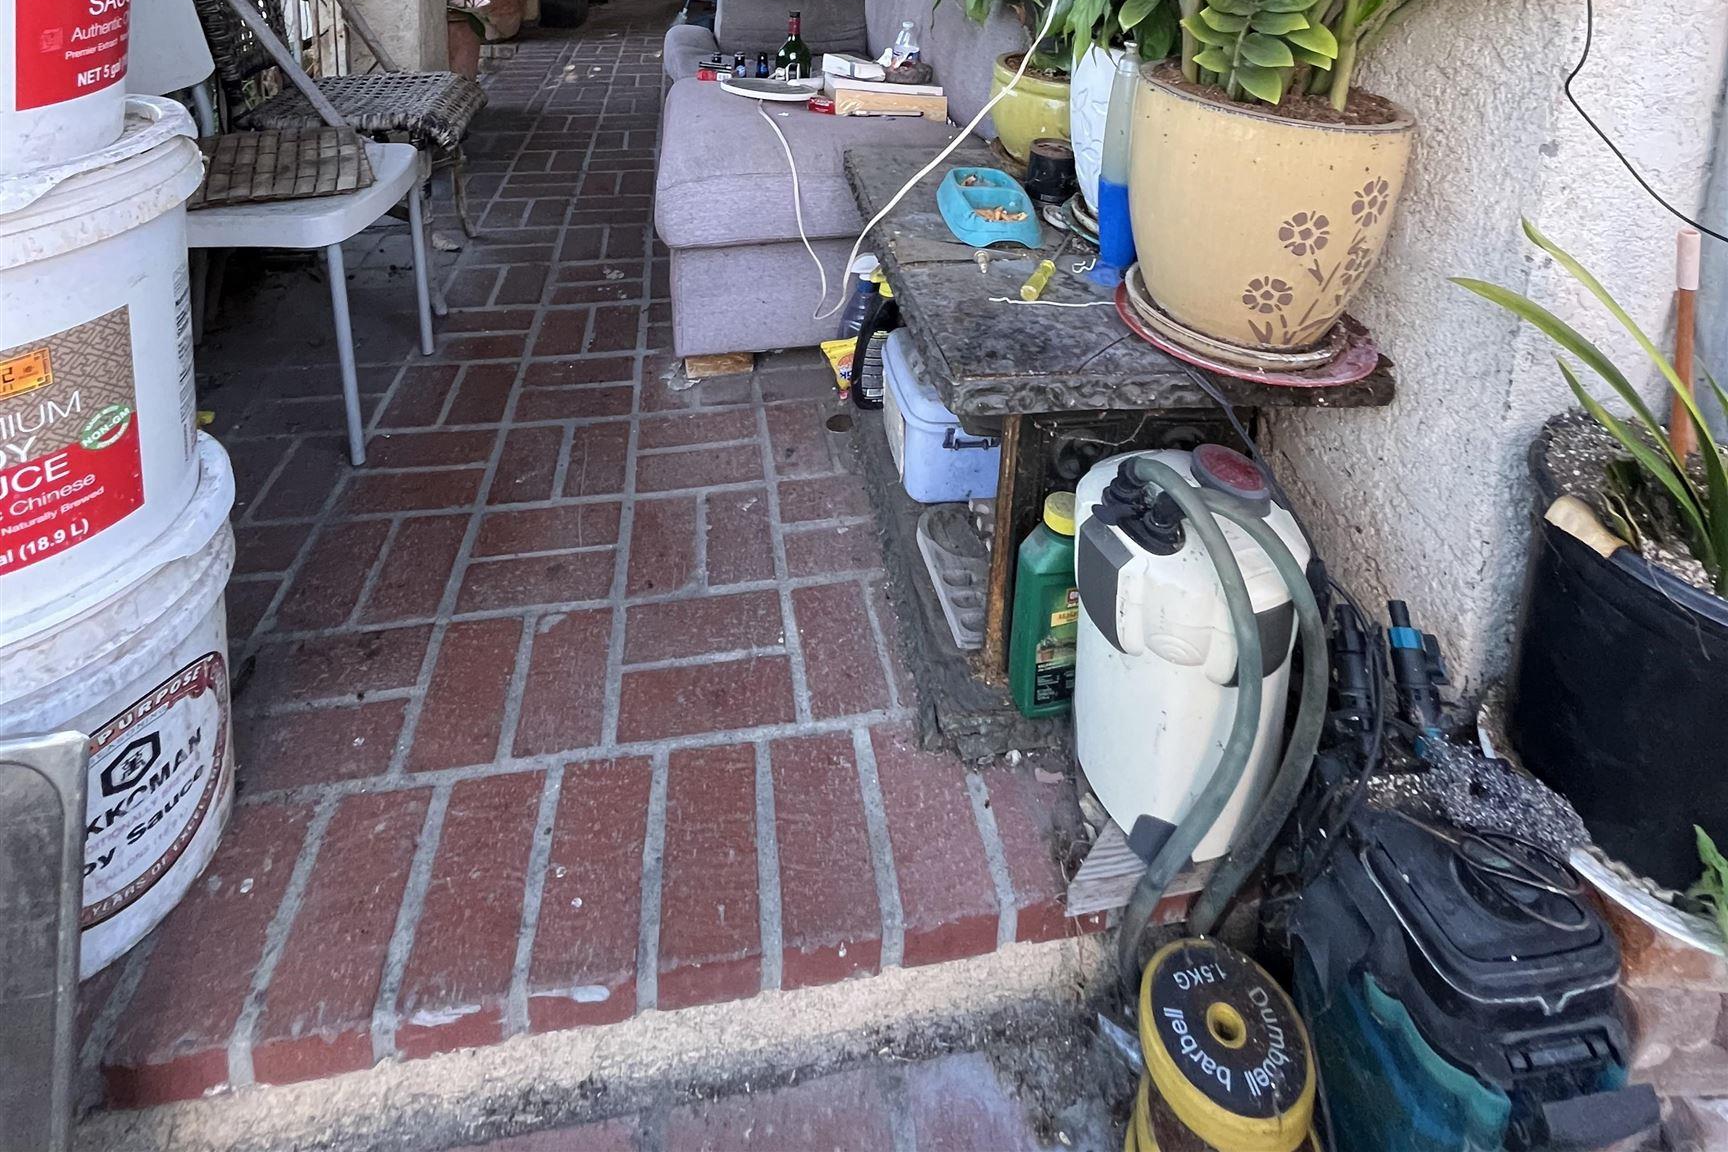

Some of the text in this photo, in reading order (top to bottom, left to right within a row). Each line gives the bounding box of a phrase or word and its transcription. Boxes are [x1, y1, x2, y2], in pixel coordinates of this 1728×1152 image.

[78, 67, 102, 87] NET
[104, 64, 109, 77] 5
[1, 486, 104, 536] Naturally Brewed
[9, 474, 96, 516] Chinese
[19, 530, 66, 561] (18.9
[97, 665, 202, 746] PURPOSE
[126, 765, 204, 845] Sauce
[1173, 963, 1227, 990] 1.5KG
[1163, 1007, 1231, 1093] barbell
